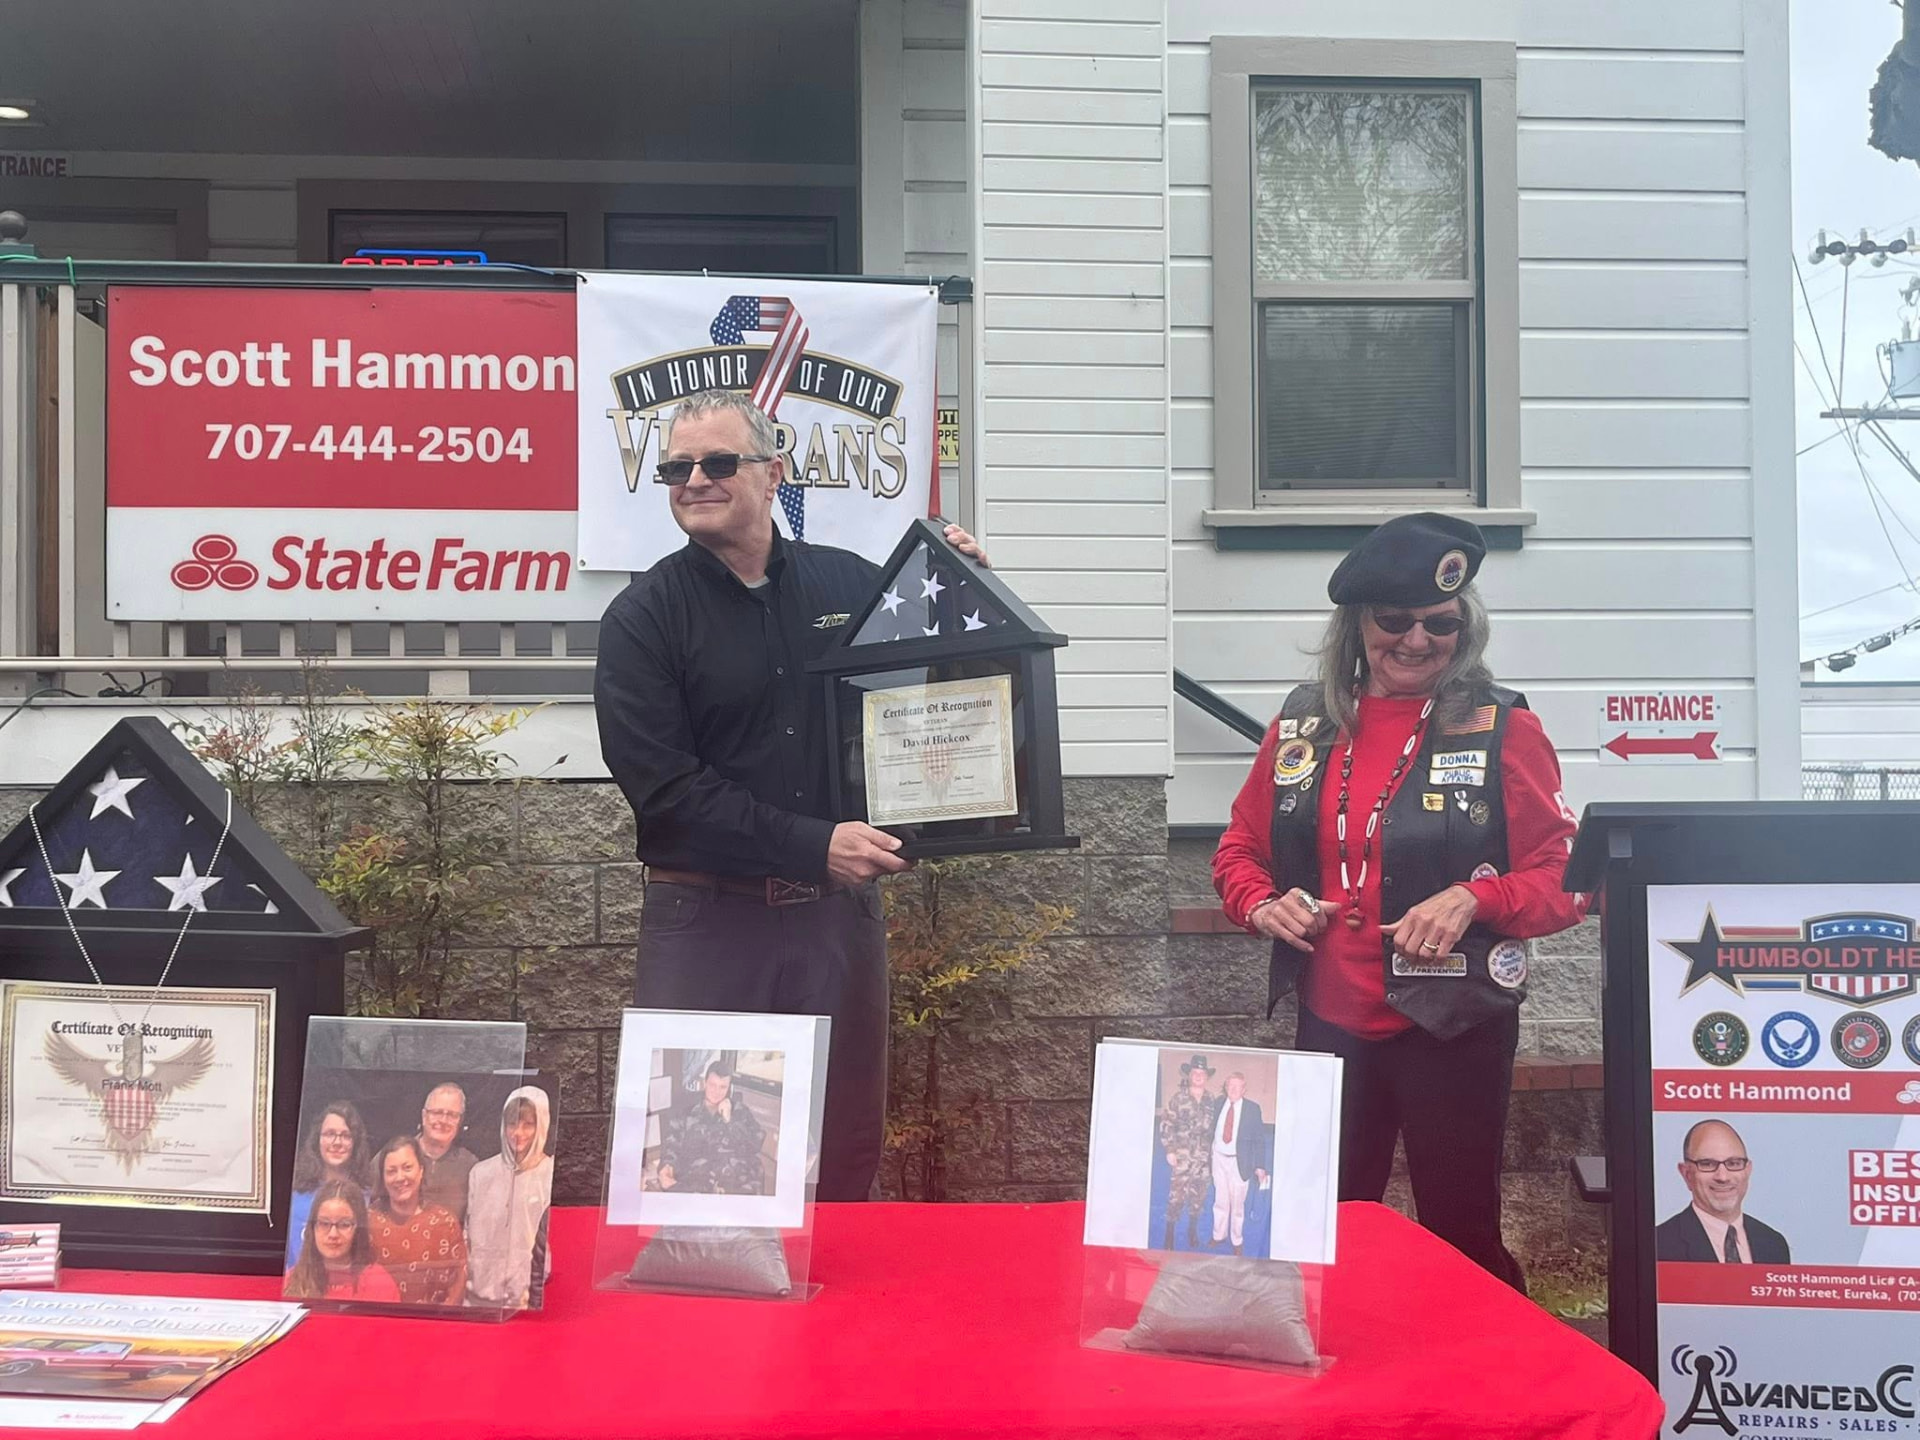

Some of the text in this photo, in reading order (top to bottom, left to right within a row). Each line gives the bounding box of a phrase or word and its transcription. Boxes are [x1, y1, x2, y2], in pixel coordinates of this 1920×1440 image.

[128, 335, 291, 388] Scott
[626, 354, 887, 415] IN HONOR OF OUR
[205, 422, 534, 463] 707-444-2504
[606, 408, 907, 499] VRANS
[883, 699, 993, 719] Certificate Of Recognition
[1606, 695, 1715, 722] ENTRANCE
[902, 734, 971, 748] David Hickcox
[1440, 753, 1478, 766] DONNA
[1716, 947, 1879, 969] HUMBOLDT
[1416, 967, 1466, 975] PREVENTION
[50, 1020, 213, 1040] Certificate Of Recognition
[101, 1079, 162, 1092] Frank Mott
[1664, 1080, 1851, 1101] Scott Hammond
[1766, 1272, 1798, 1283] Scott
[1801, 1273, 1866, 1286] Hammond
[1869, 1275, 1896, 1286] Lic#
[1751, 1286, 1772, 1297] 537
[1775, 1286, 1796, 1298] 7th
[1844, 1288, 1891, 1302] Eureka,
[1739, 1414, 1898, 1432] REPAIRS SALES
